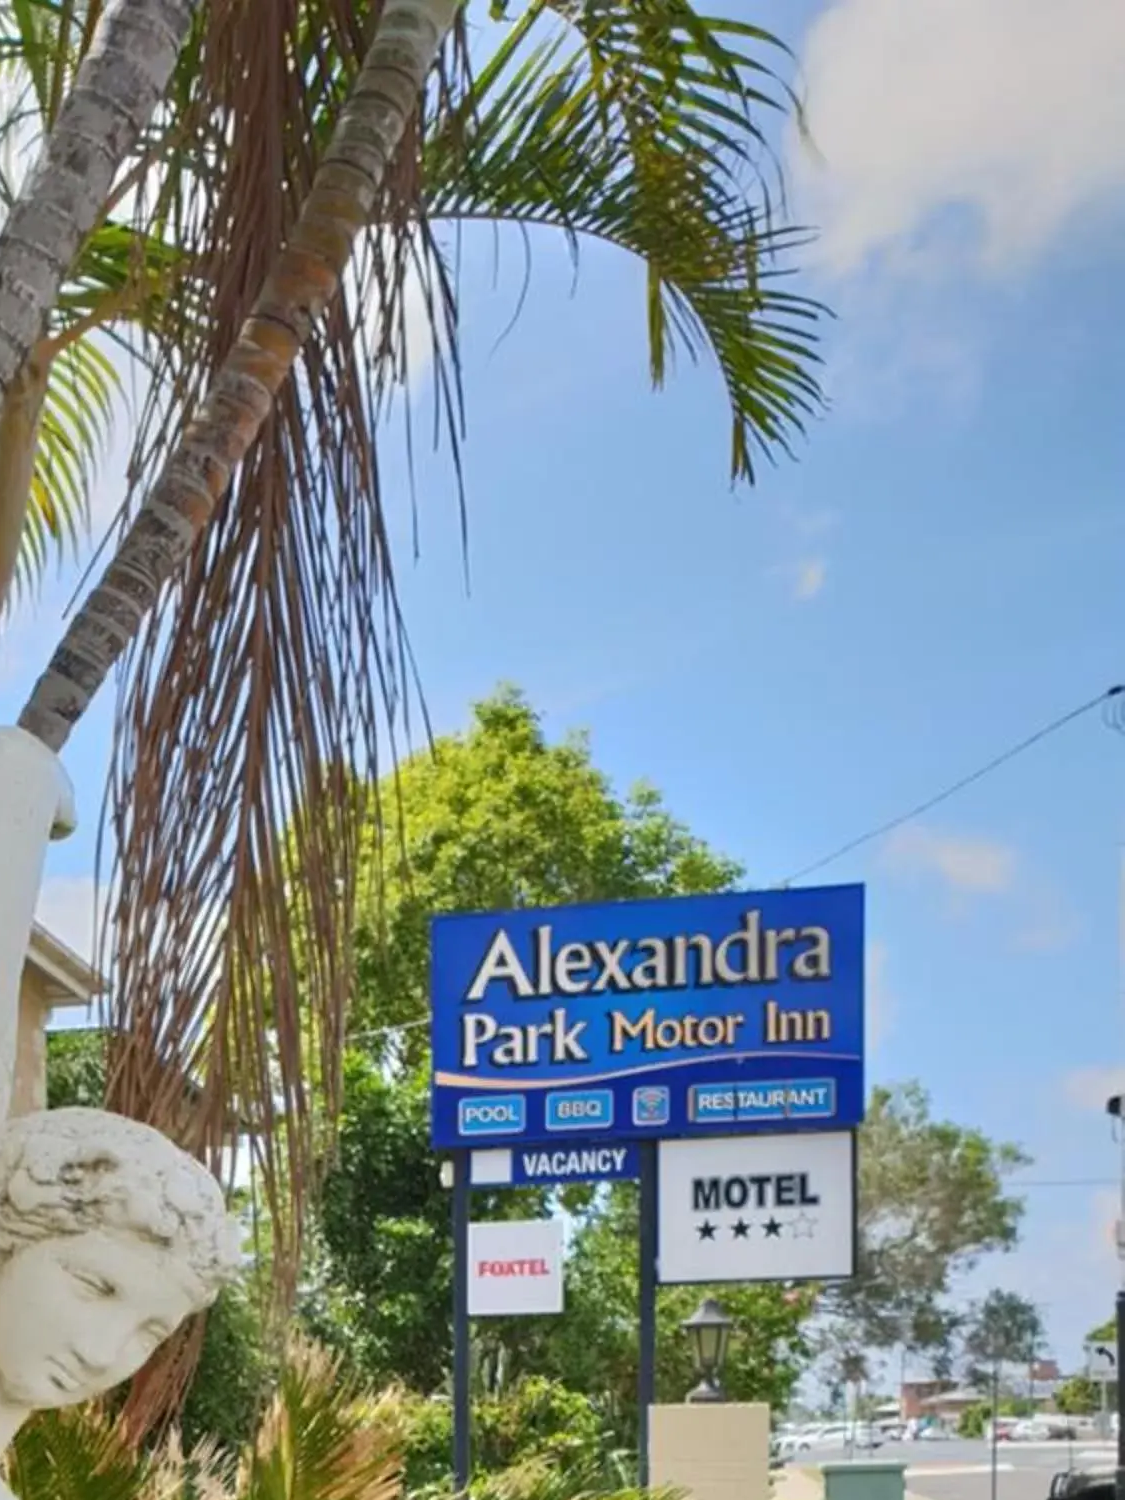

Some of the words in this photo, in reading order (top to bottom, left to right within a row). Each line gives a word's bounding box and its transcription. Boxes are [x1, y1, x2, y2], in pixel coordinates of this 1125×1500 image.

[466, 909, 831, 1001] Alexandra
[462, 1007, 588, 1067] Park
[612, 1008, 744, 1052] Motor
[765, 1000, 830, 1043] Inn
[557, 1102, 602, 1119] BBQ
[698, 1086, 828, 1111] RESTAURANT
[464, 1102, 520, 1123] POOL
[523, 1148, 628, 1177] VACANCY
[691, 1172, 820, 1210] MOTEL
[478, 1258, 551, 1278] FOXTEL
